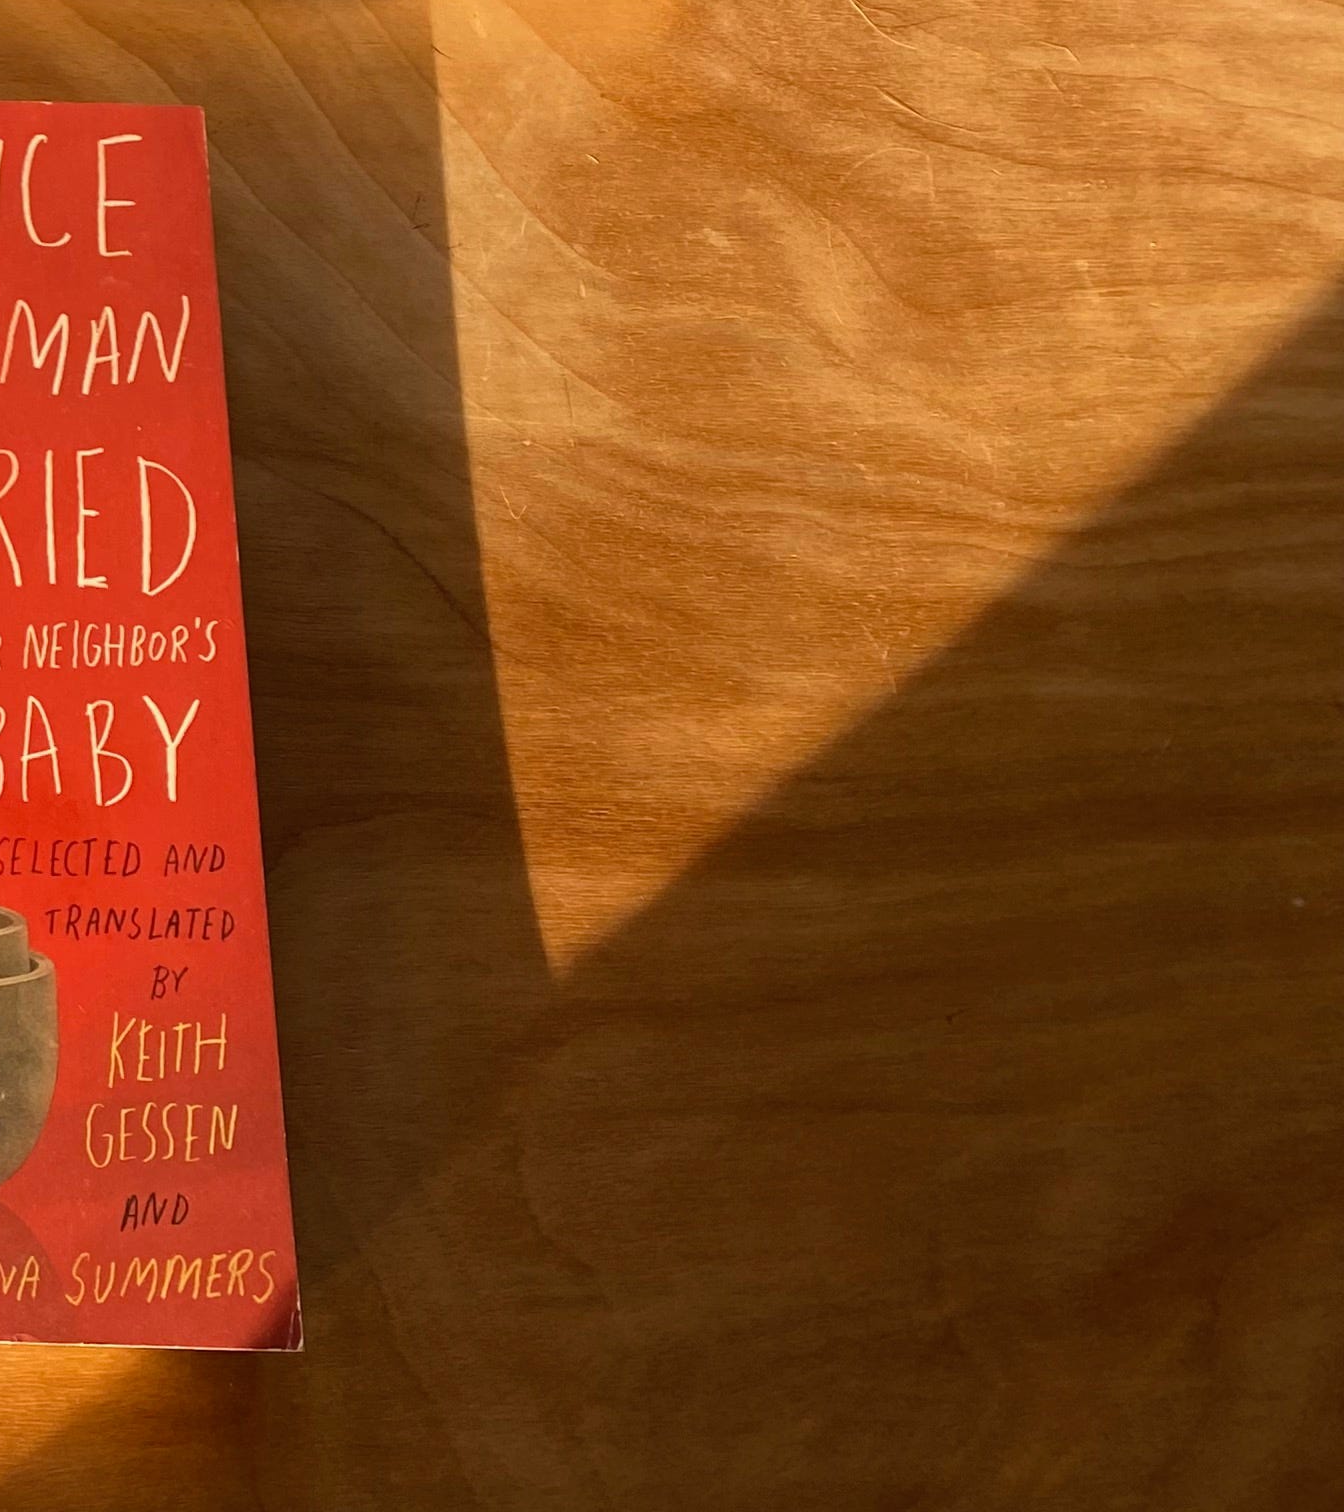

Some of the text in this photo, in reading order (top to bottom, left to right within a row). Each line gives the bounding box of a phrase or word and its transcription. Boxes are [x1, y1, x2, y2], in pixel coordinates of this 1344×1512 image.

[21, 620, 219, 672] NEIGHBOR'S
[164, 843, 227, 876] AND
[44, 906, 237, 943] TRANSLATED
[151, 965, 190, 1002] BY
[109, 1012, 229, 1088] KEITH
[85, 1102, 238, 1169] GESSEN
[119, 1193, 191, 1233] AND
[72, 1249, 277, 1307] SUMMERS
